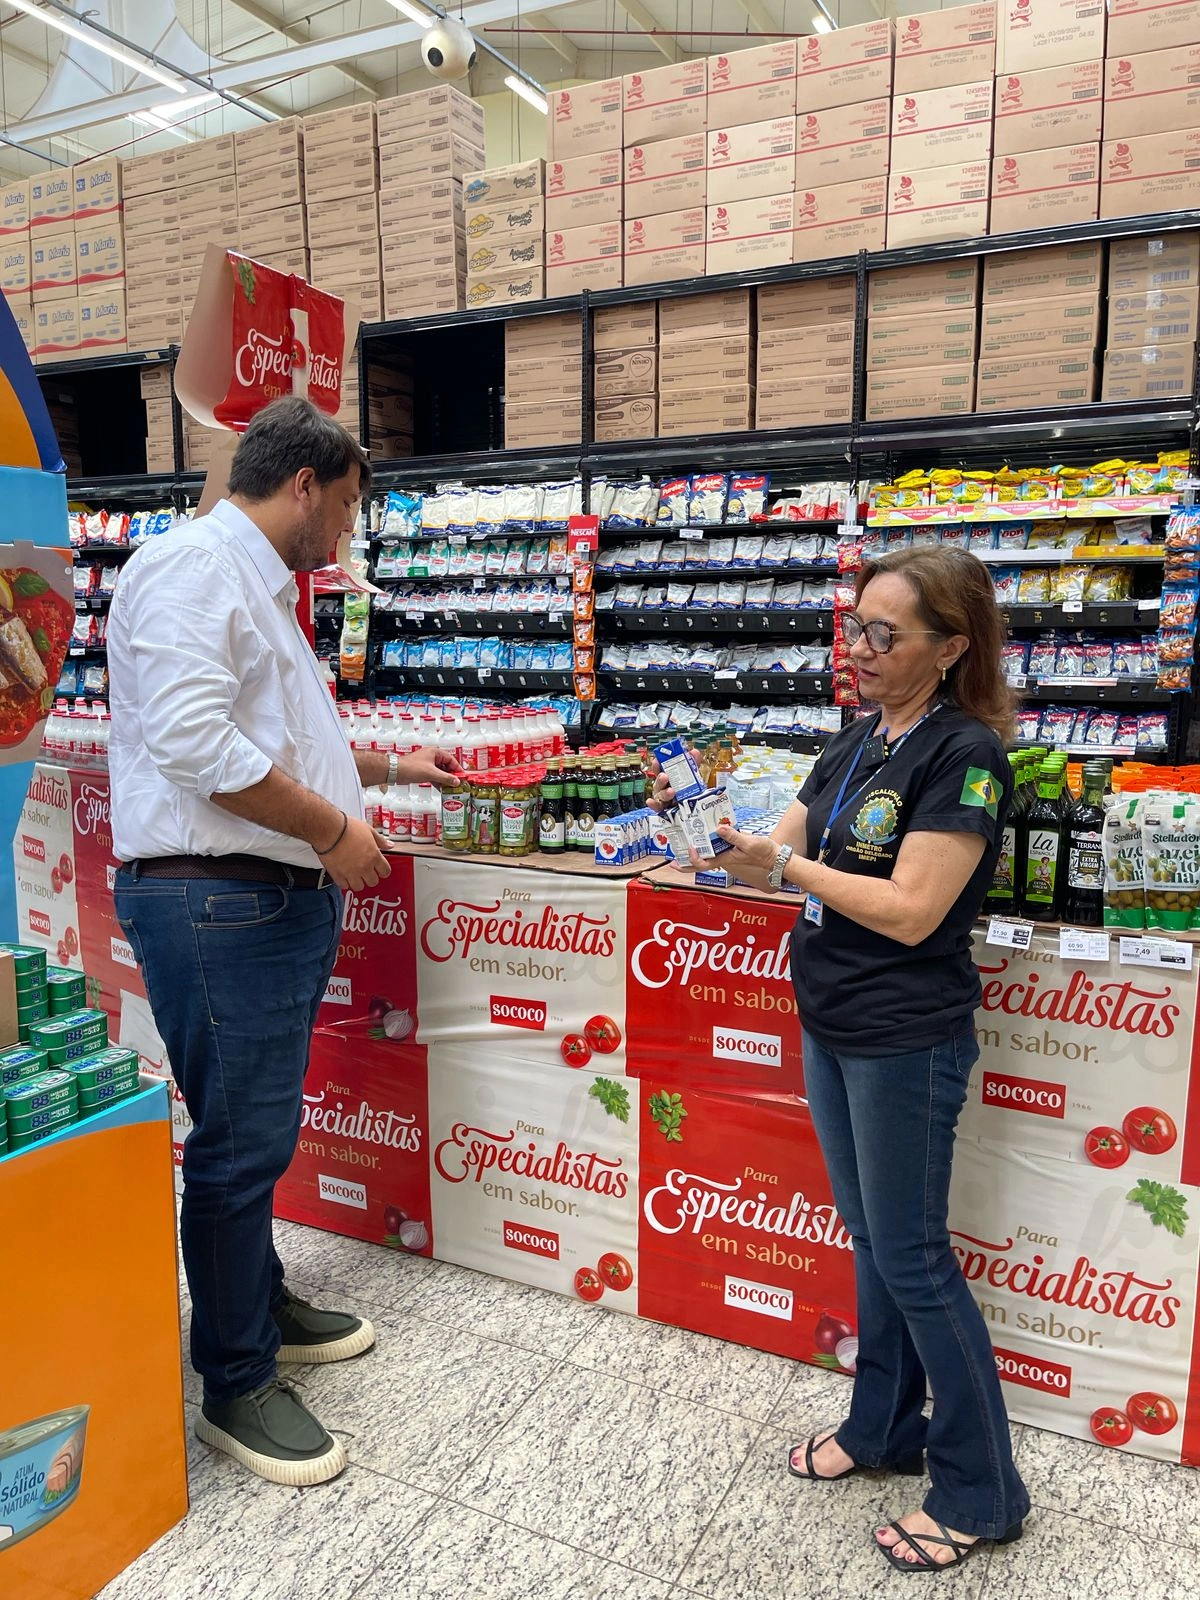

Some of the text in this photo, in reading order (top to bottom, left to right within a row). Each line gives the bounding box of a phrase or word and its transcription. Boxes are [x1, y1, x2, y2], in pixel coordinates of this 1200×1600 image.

[46, 180, 68, 196] Maria
[90, 172, 112, 188] Maria
[5, 193, 25, 208] Maria
[49, 245, 70, 261] Maria
[94, 237, 116, 253] Maria
[5, 254, 25, 268] Maria
[96, 303, 118, 319] Maria
[570, 527, 597, 537] NESCAFÉ
[856, 841, 883, 852] INMETRO
[1032, 832, 1054, 851] La
[1076, 842, 1102, 850] TERRAN
[502, 888, 532, 903] Para
[733, 909, 768, 927] Para
[420, 899, 617, 963] Especialistas
[1011, 948, 1054, 964] Para
[1135, 948, 1151, 956] 7,49
[470, 957, 567, 982] em sabor.
[690, 984, 726, 1004] em
[493, 1004, 545, 1023] SOCOCO
[65, 1029, 83, 1043] 88
[66, 1044, 84, 1059] 88
[716, 1035, 779, 1058] SOCOCO
[1010, 1030, 1100, 1064] sabor.
[2, 1069, 20, 1083] 88
[97, 1069, 114, 1082] 88
[99, 1085, 116, 1100] 88
[326, 1081, 350, 1096] Para
[986, 1081, 1062, 1109] SOCOCO
[32, 1094, 50, 1110] 88
[32, 1112, 51, 1129] 88
[516, 1120, 545, 1136] Para
[300, 1140, 382, 1171] em sabor.
[434, 1123, 629, 1199] Especialistas
[744, 1166, 778, 1185] Para
[322, 1182, 365, 1202] SOCOCO
[483, 1182, 580, 1218] em sabor.
[506, 1229, 557, 1252] SOCOCO
[1016, 1226, 1059, 1248] Para
[702, 1233, 818, 1275] em sabor.
[701, 1281, 815, 1313] DESDE SOCOCO 1966
[1016, 1313, 1104, 1349] sabor.
[14, 1463, 34, 1482] ATUM
[1, 1472, 45, 1501] Sólido
[3, 1488, 39, 1517] NATURAL
